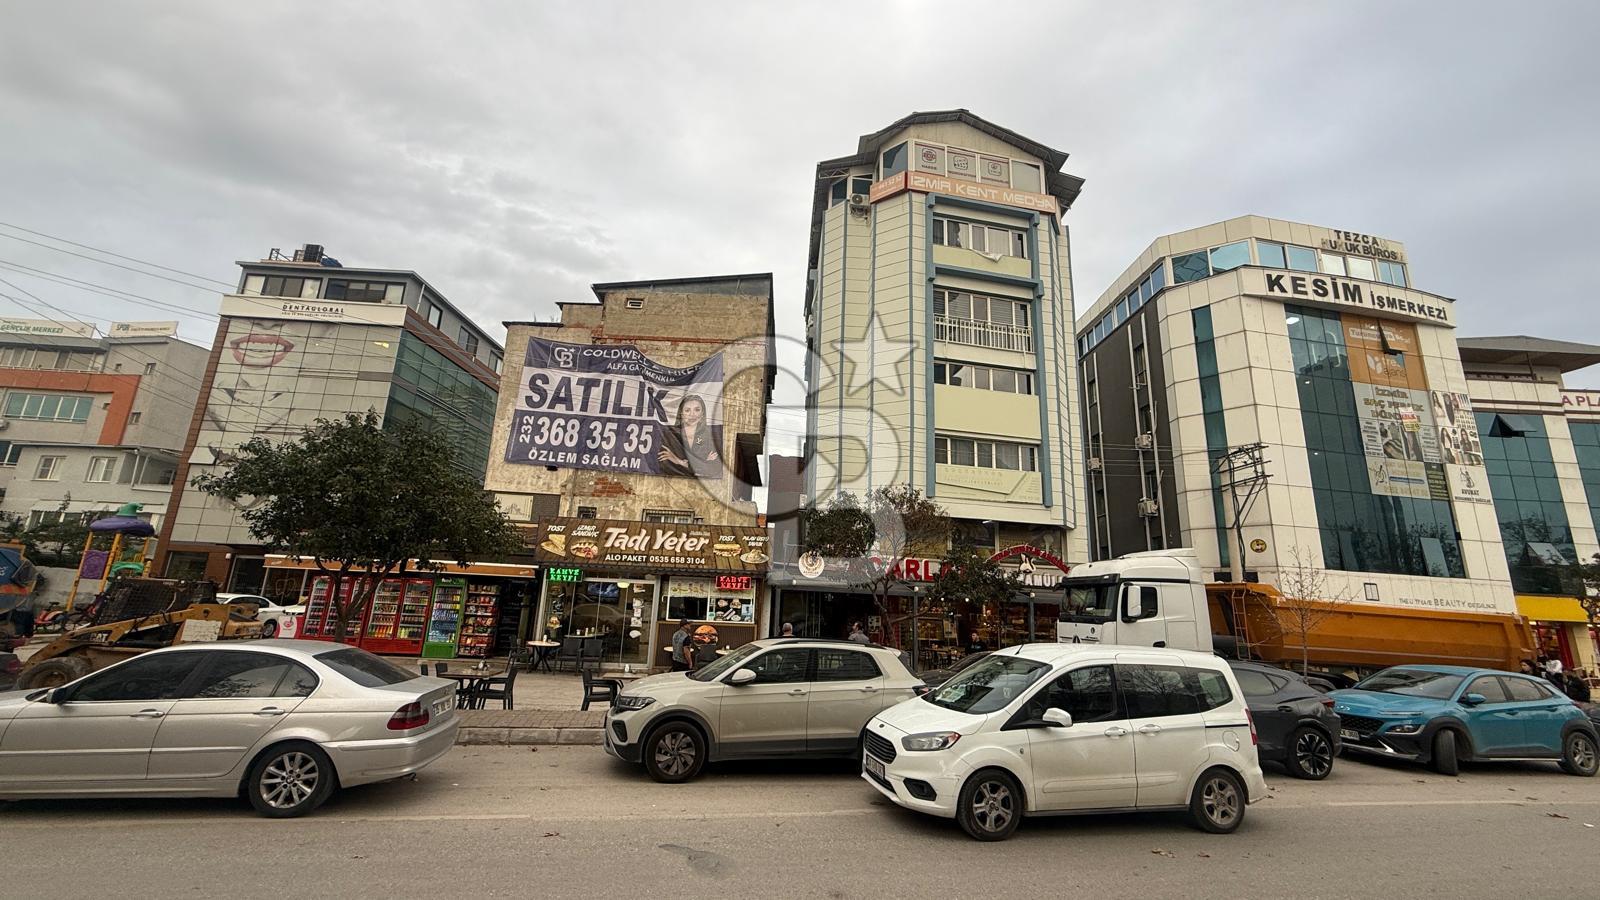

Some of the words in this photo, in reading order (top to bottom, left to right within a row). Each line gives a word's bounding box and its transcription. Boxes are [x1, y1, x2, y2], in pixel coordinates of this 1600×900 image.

[955, 183, 997, 199] KENT
[1003, 191, 1054, 209] MEDYA
[1266, 273, 1363, 303] KESİM
[1370, 291, 1447, 320] İŞMERKEZİ
[607, 362, 627, 370] ALFA
[525, 373, 669, 422] SATILIK
[520, 415, 534, 444] 232
[534, 416, 580, 447] 368
[586, 421, 618, 450] 35
[623, 423, 653, 454] 35
[528, 446, 577, 463] ÖZLEM
[581, 453, 641, 469] SAĞLAM
[604, 527, 650, 551] Tadı
[653, 529, 709, 552] Yeter
